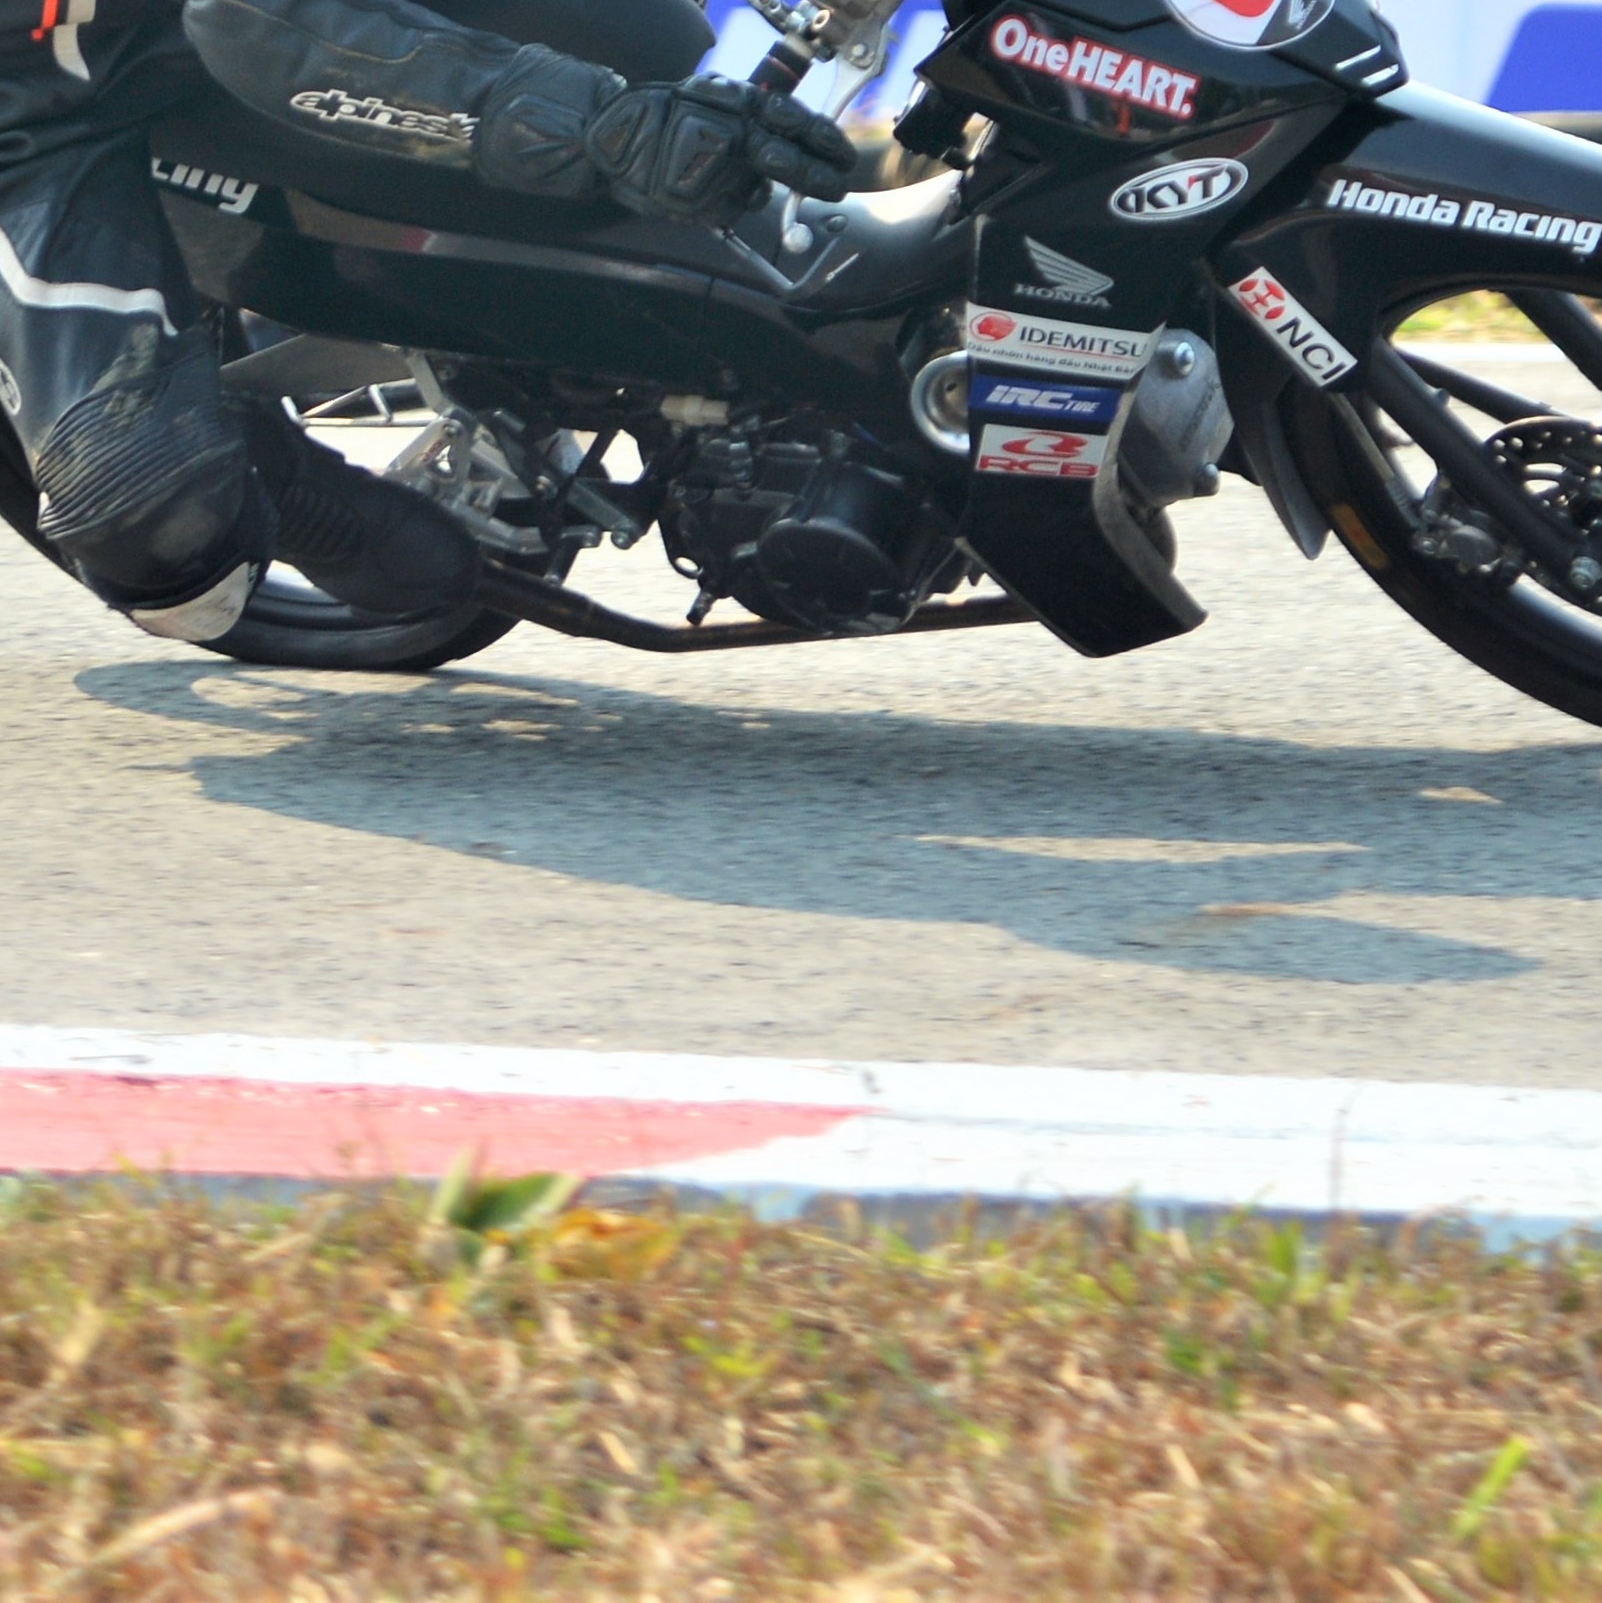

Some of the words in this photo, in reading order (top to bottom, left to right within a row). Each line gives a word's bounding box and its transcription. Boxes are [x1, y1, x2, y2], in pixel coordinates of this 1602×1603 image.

[1129, 163, 1231, 214] KYT
[1327, 177, 1461, 226] Honda
[1013, 283, 1111, 308] HONDA
[1018, 325, 1148, 358] IDEMITSU
[1275, 317, 1349, 381] NCI
[985, 384, 1073, 410] IRC
[1063, 399, 1101, 414] TIRE
[977, 454, 1099, 478] RCB
